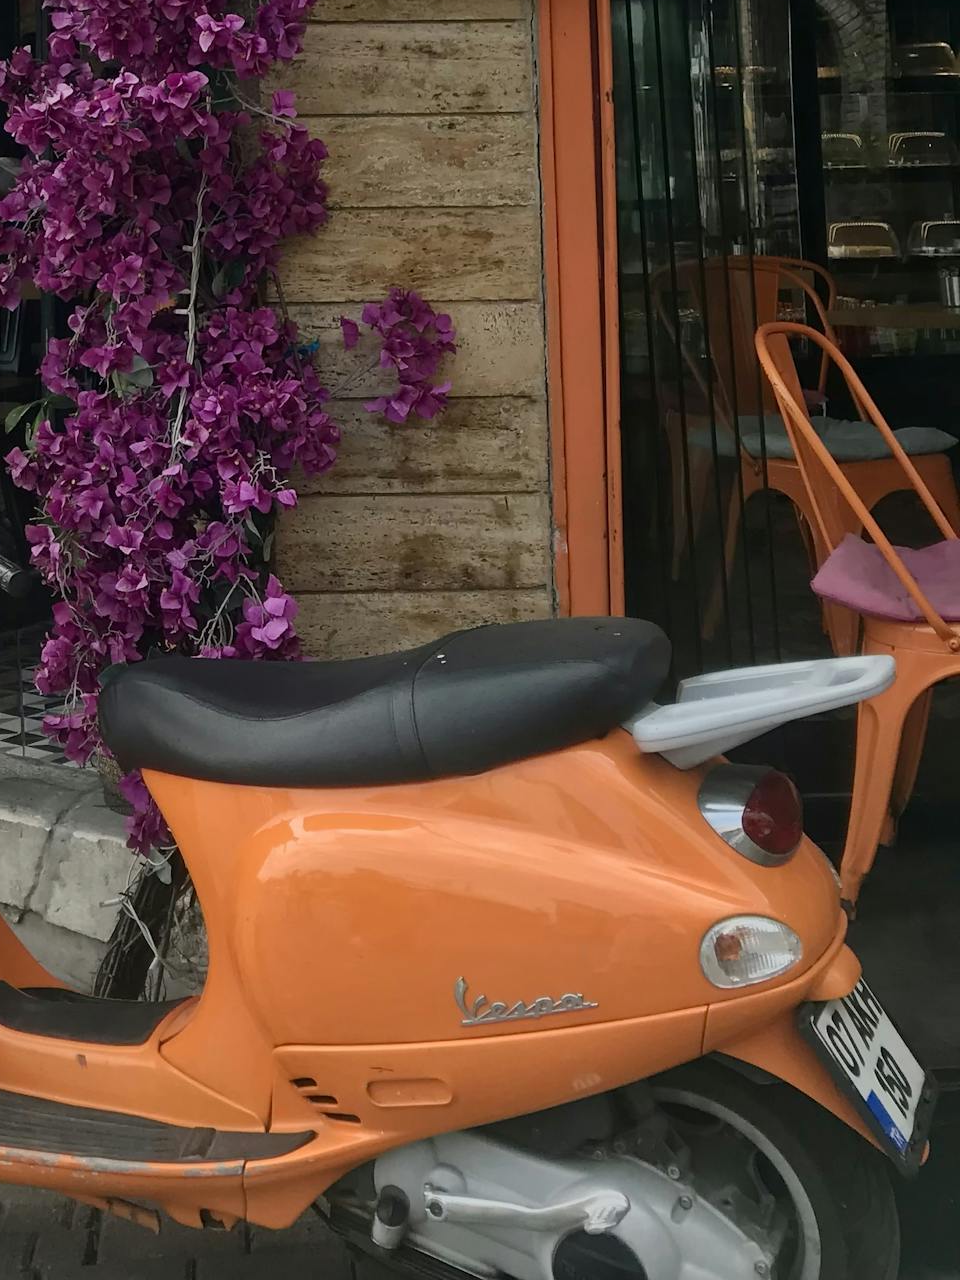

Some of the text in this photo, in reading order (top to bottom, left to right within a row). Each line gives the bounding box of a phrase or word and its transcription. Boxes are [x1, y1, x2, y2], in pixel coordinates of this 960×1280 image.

[454, 976, 599, 1026] Vespa
[826, 1009, 866, 1078] 07
[873, 1046, 913, 1120] 150
